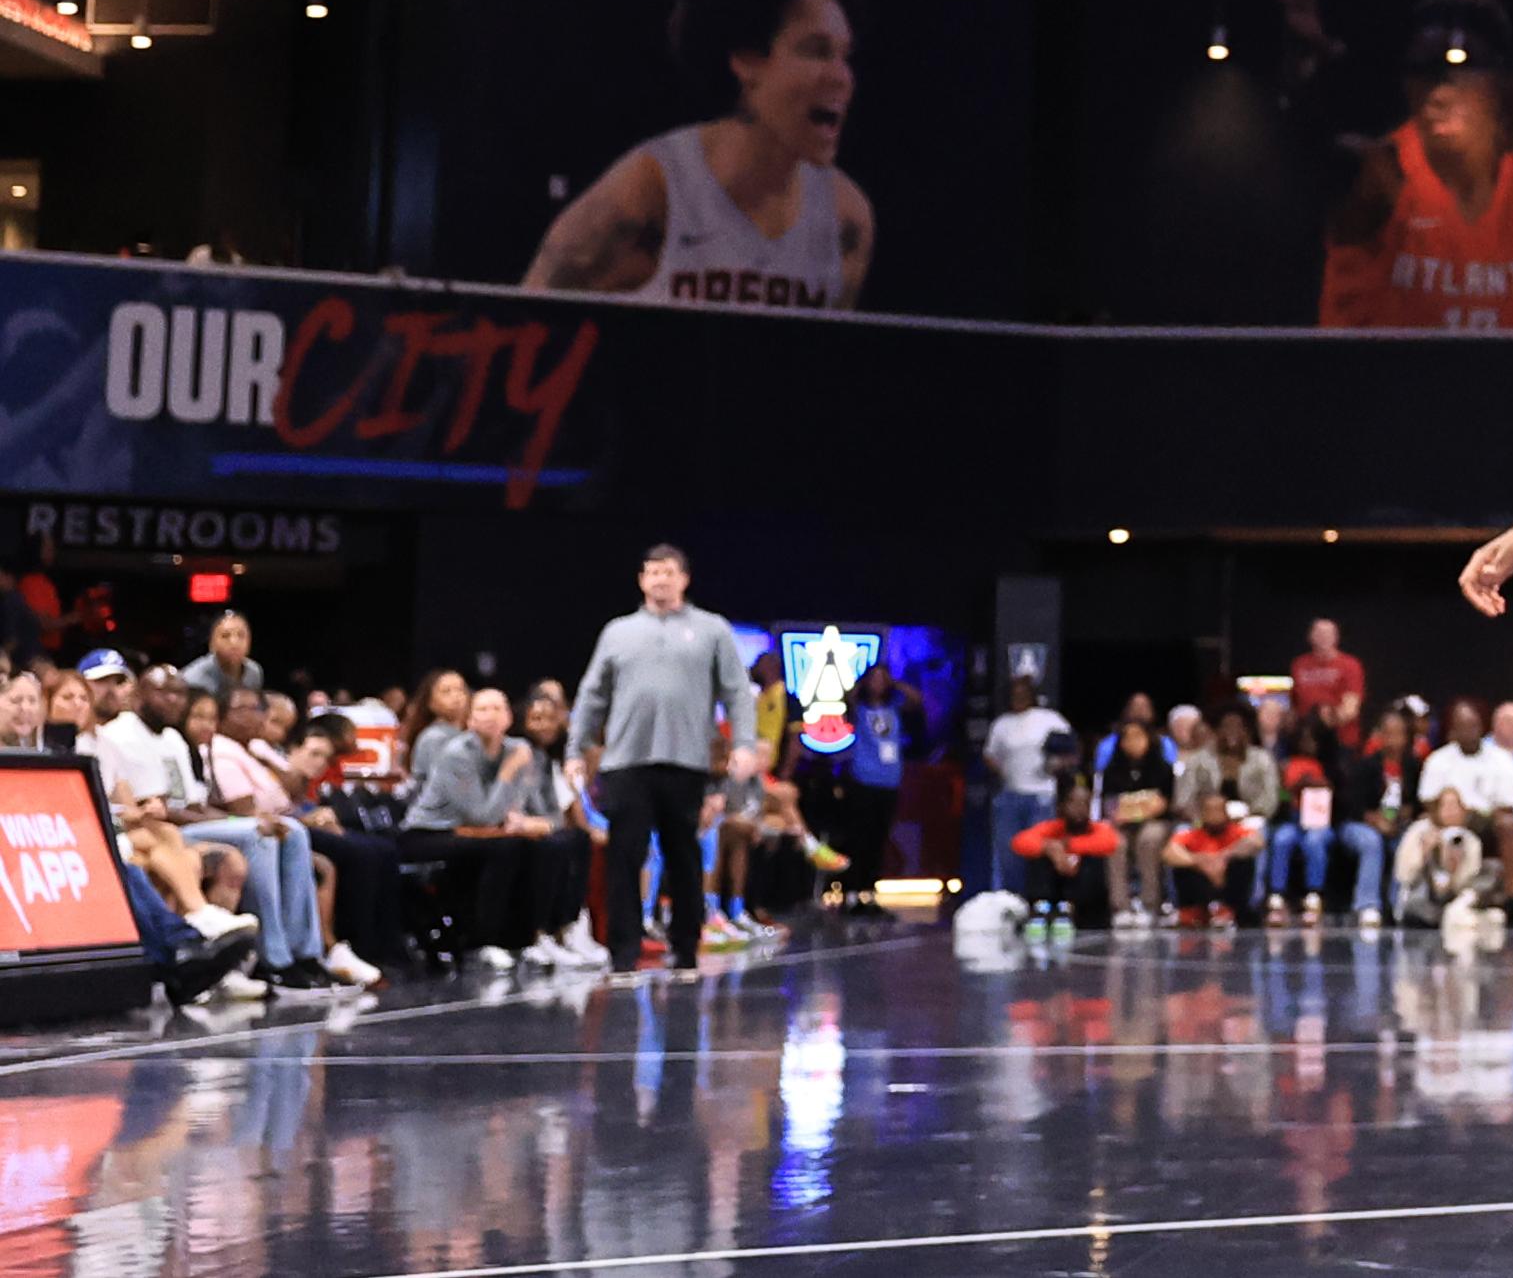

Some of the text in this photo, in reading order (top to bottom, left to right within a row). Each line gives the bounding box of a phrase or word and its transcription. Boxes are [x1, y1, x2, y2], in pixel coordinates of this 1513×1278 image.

[106, 295, 598, 509] OUR CITY
[26, 501, 342, 553] RESTROOMS
[0, 813, 78, 849] WNBA
[19, 850, 90, 904] APP
